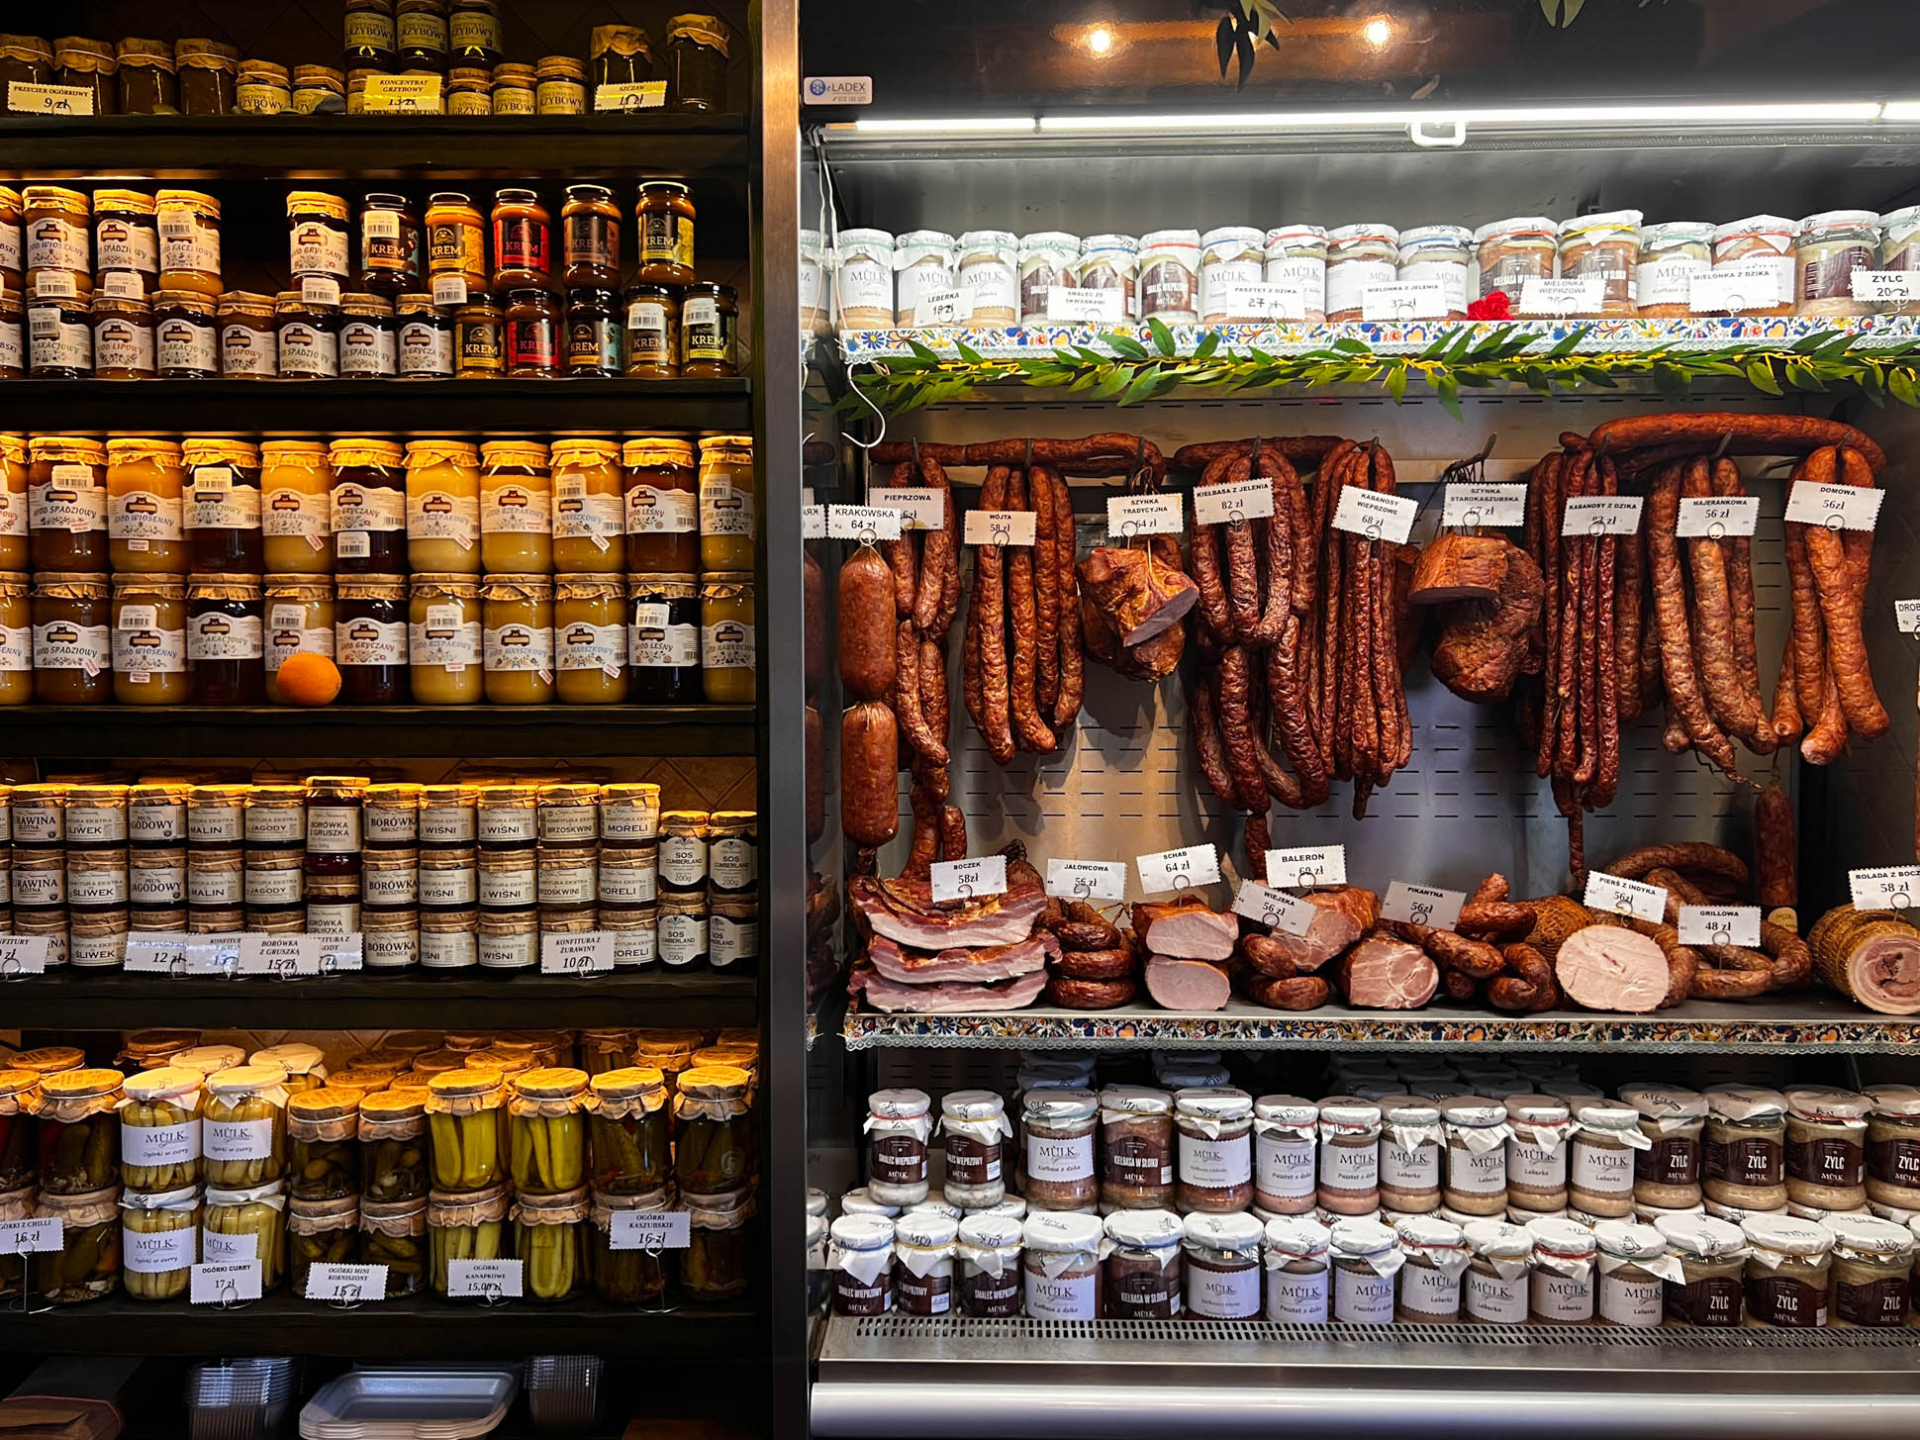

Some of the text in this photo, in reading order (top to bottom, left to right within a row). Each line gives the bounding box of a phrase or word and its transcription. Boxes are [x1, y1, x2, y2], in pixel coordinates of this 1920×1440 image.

[44, 98, 68, 109] 9 zł
[645, 236, 674, 246] KREM
[371, 244, 405, 256] KREM
[431, 245, 462, 256] KREM
[505, 242, 538, 253] KREM
[928, 292, 959, 303] LEBERKA
[1877, 288, 1890, 297] 20
[691, 335, 724, 346] KREM
[465, 344, 498, 355] KREM
[570, 342, 600, 352] KREM
[1197, 488, 1231, 497] KIEŁBASA
[1239, 483, 1268, 492] JELENIA
[1820, 486, 1856, 496] DOMOWA
[1222, 500, 1244, 509] 82 zł
[1361, 493, 1399, 506] KABANOSY
[1822, 500, 1845, 510] 56zł
[49, 505, 97, 519] SPADZIOWY
[200, 503, 242, 516] AKACJOWY
[342, 505, 380, 518] GRYCZANY
[641, 507, 665, 519] LEŚNY
[835, 509, 894, 518] KRAKOWSKA
[1123, 506, 1168, 514] TRADYCYJNA
[1357, 501, 1398, 515] WIEPRZOWE
[1705, 509, 1730, 518] 56 zł
[133, 513, 174, 528] WIOSENNY
[851, 520, 876, 529] 64 zł
[1135, 519, 1157, 528] 64 zł
[1362, 515, 1384, 526] 68 zł
[204, 634, 249, 646] AKACJOWY
[355, 639, 395, 651] GRYCZANY
[49, 646, 98, 658] SPADZIOWY
[649, 642, 673, 653] LEŚNY
[137, 648, 177, 659] WIOSENNY
[191, 826, 222, 834] MALIN
[425, 826, 456, 834] WIŚNI
[487, 826, 519, 834] WIŚNI
[548, 825, 592, 833] BRZOSKWINI
[608, 824, 648, 832] MORELI
[1163, 851, 1187, 860] SCHAB
[1281, 854, 1325, 862] BALERON
[953, 862, 981, 870] BOCZEK
[1166, 861, 1190, 872] 64 zł
[958, 873, 979, 884] 58zł
[1089, 878, 1097, 887] zł
[1599, 876, 1620, 887] PIERŚ
[1628, 884, 1656, 895] INDYKA
[1880, 881, 1909, 893] 58 zł
[73, 888, 114, 897] ŚLIWEK
[191, 889, 224, 897] MALIN
[423, 889, 454, 897] WIŚNI
[489, 890, 521, 898] WIŚNI
[1407, 887, 1443, 898] PIKANTNA
[1264, 890, 1295, 907] WIEJSKA
[1262, 902, 1286, 916] 56 zł
[1410, 901, 1433, 914] 56zł
[1705, 921, 1731, 931] 48 zł
[368, 942, 416, 951] BORÓWKA
[556, 937, 596, 946] KONFITURA
[4, 948, 16, 960] zł
[75, 950, 115, 959] ŚLIWEK
[560, 945, 596, 954] ŻURAWINY
[153, 953, 167, 963] 12
[483, 951, 513, 960] WIŚNI
[268, 959, 296, 970] 15 zł
[562, 957, 589, 968] 10 zł
[1670, 1154, 1688, 1168] ZYLC
[1748, 1155, 1767, 1169] ZYLC
[1824, 1156, 1845, 1170] ZYLC
[1898, 1156, 1919, 1171] ZYLC
[14, 1230, 40, 1243] 16 zł
[639, 1233, 653, 1243] 16
[202, 1264, 251, 1274] OGÓRKI CURRY
[215, 1280, 225, 1288] 17
[332, 1286, 362, 1297] 15 zł
[1710, 1295, 1729, 1310] ZYLC
[1776, 1295, 1798, 1310] ZYLC
